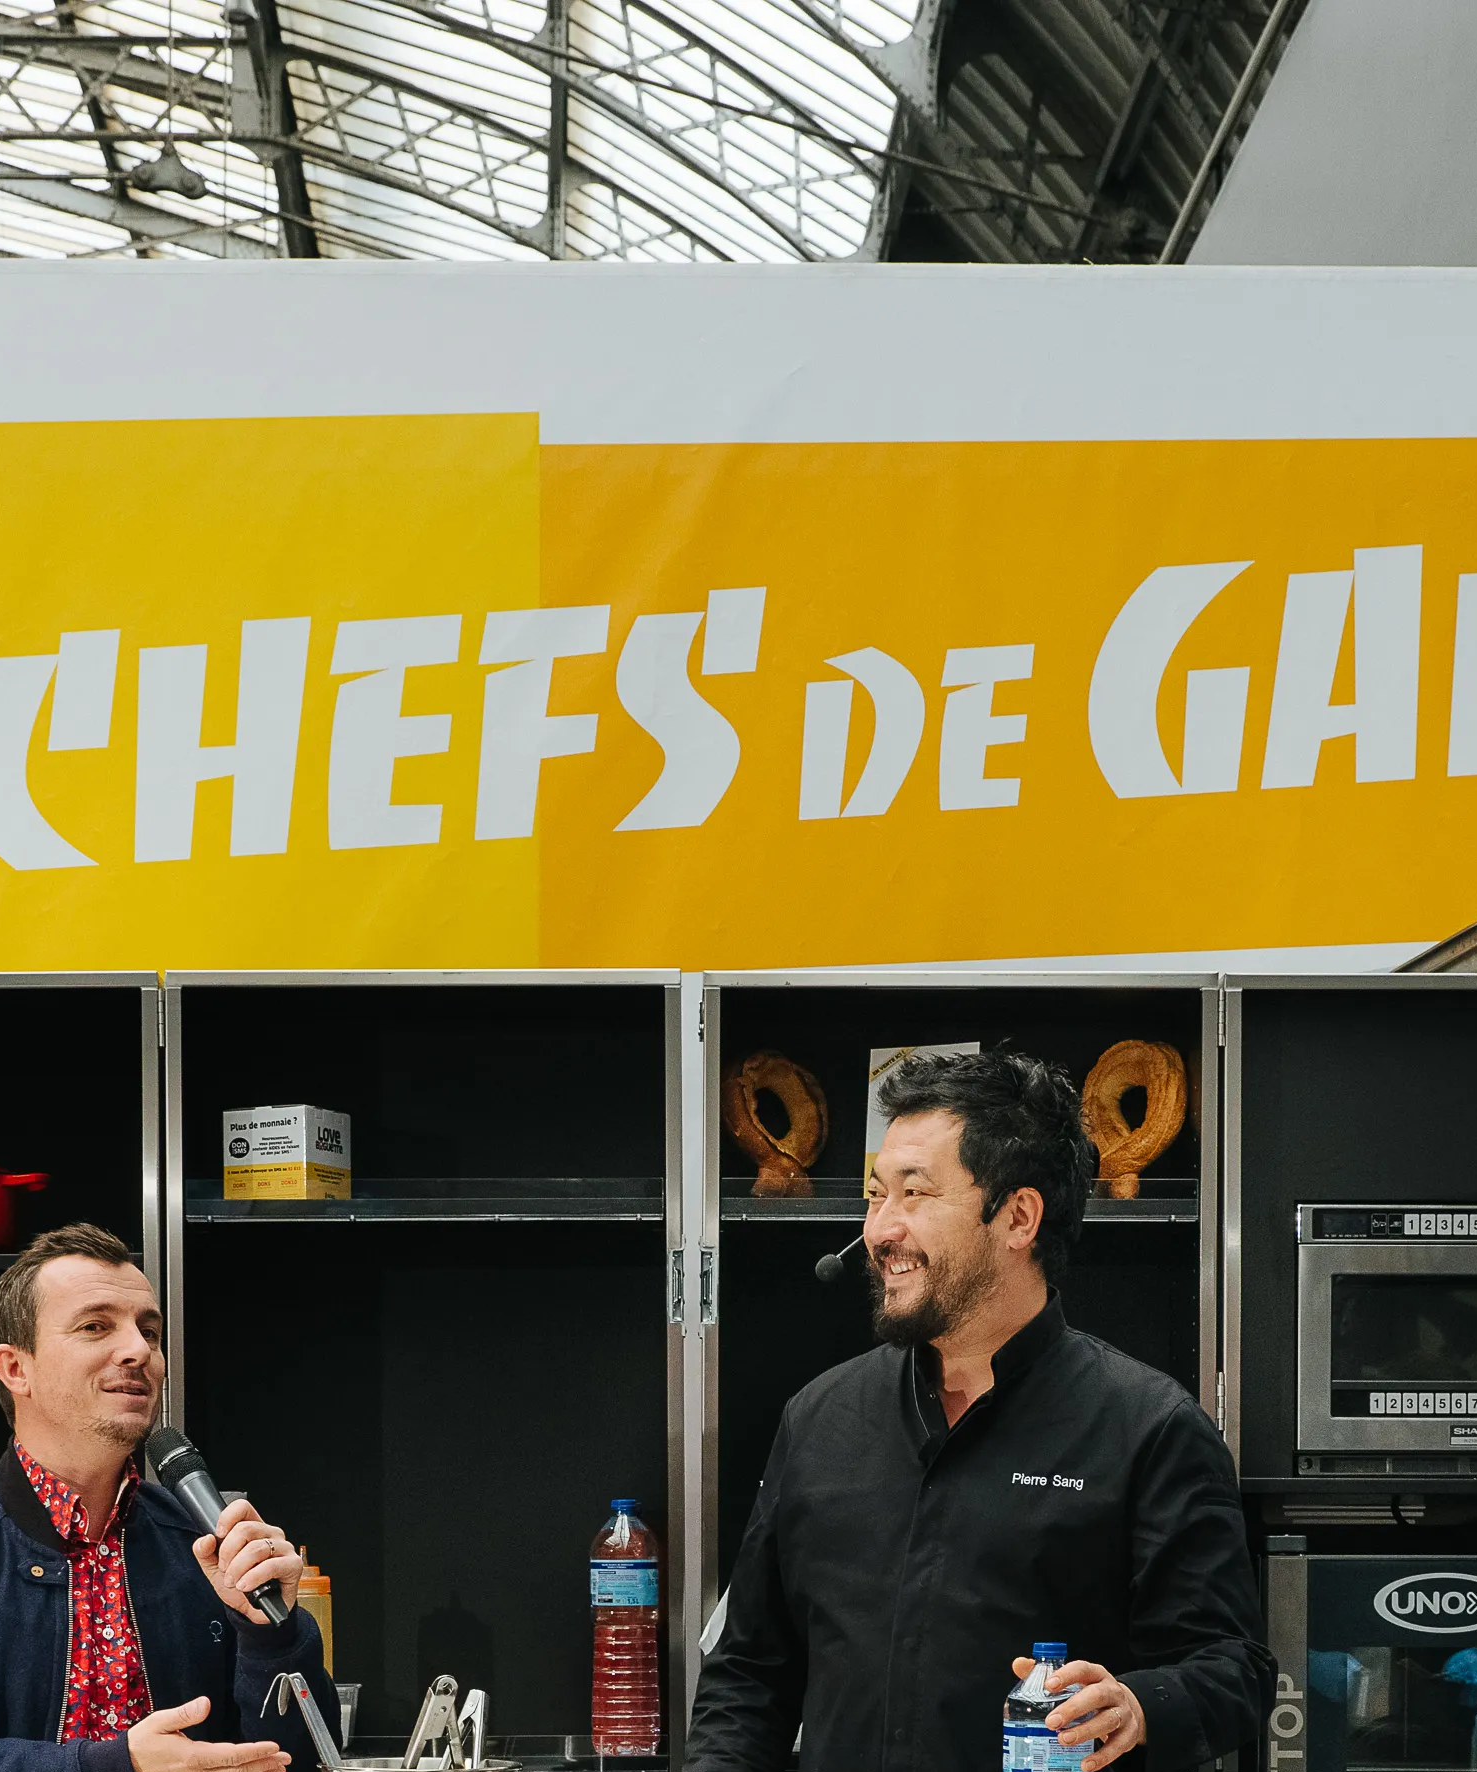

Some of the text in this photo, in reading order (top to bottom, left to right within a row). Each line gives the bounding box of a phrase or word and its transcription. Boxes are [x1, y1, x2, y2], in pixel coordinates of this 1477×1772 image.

[798, 643, 1034, 822] DE
[230, 1117, 292, 1132] Plus de monnaie
[1409, 1219, 1415, 1231] 1
[1425, 1219, 1432, 1231] 2
[1441, 1219, 1448, 1231] 3
[1457, 1219, 1465, 1231] 4
[1374, 1398, 1379, 1409] 1
[1390, 1398, 1397, 1409] 2
[1406, 1398, 1413, 1409] 3
[1422, 1398, 1429, 1409] 4
[1439, 1398, 1446, 1409] 5
[1455, 1398, 1462, 1409] 6
[1011, 1472, 1084, 1491] Pierre Sang
